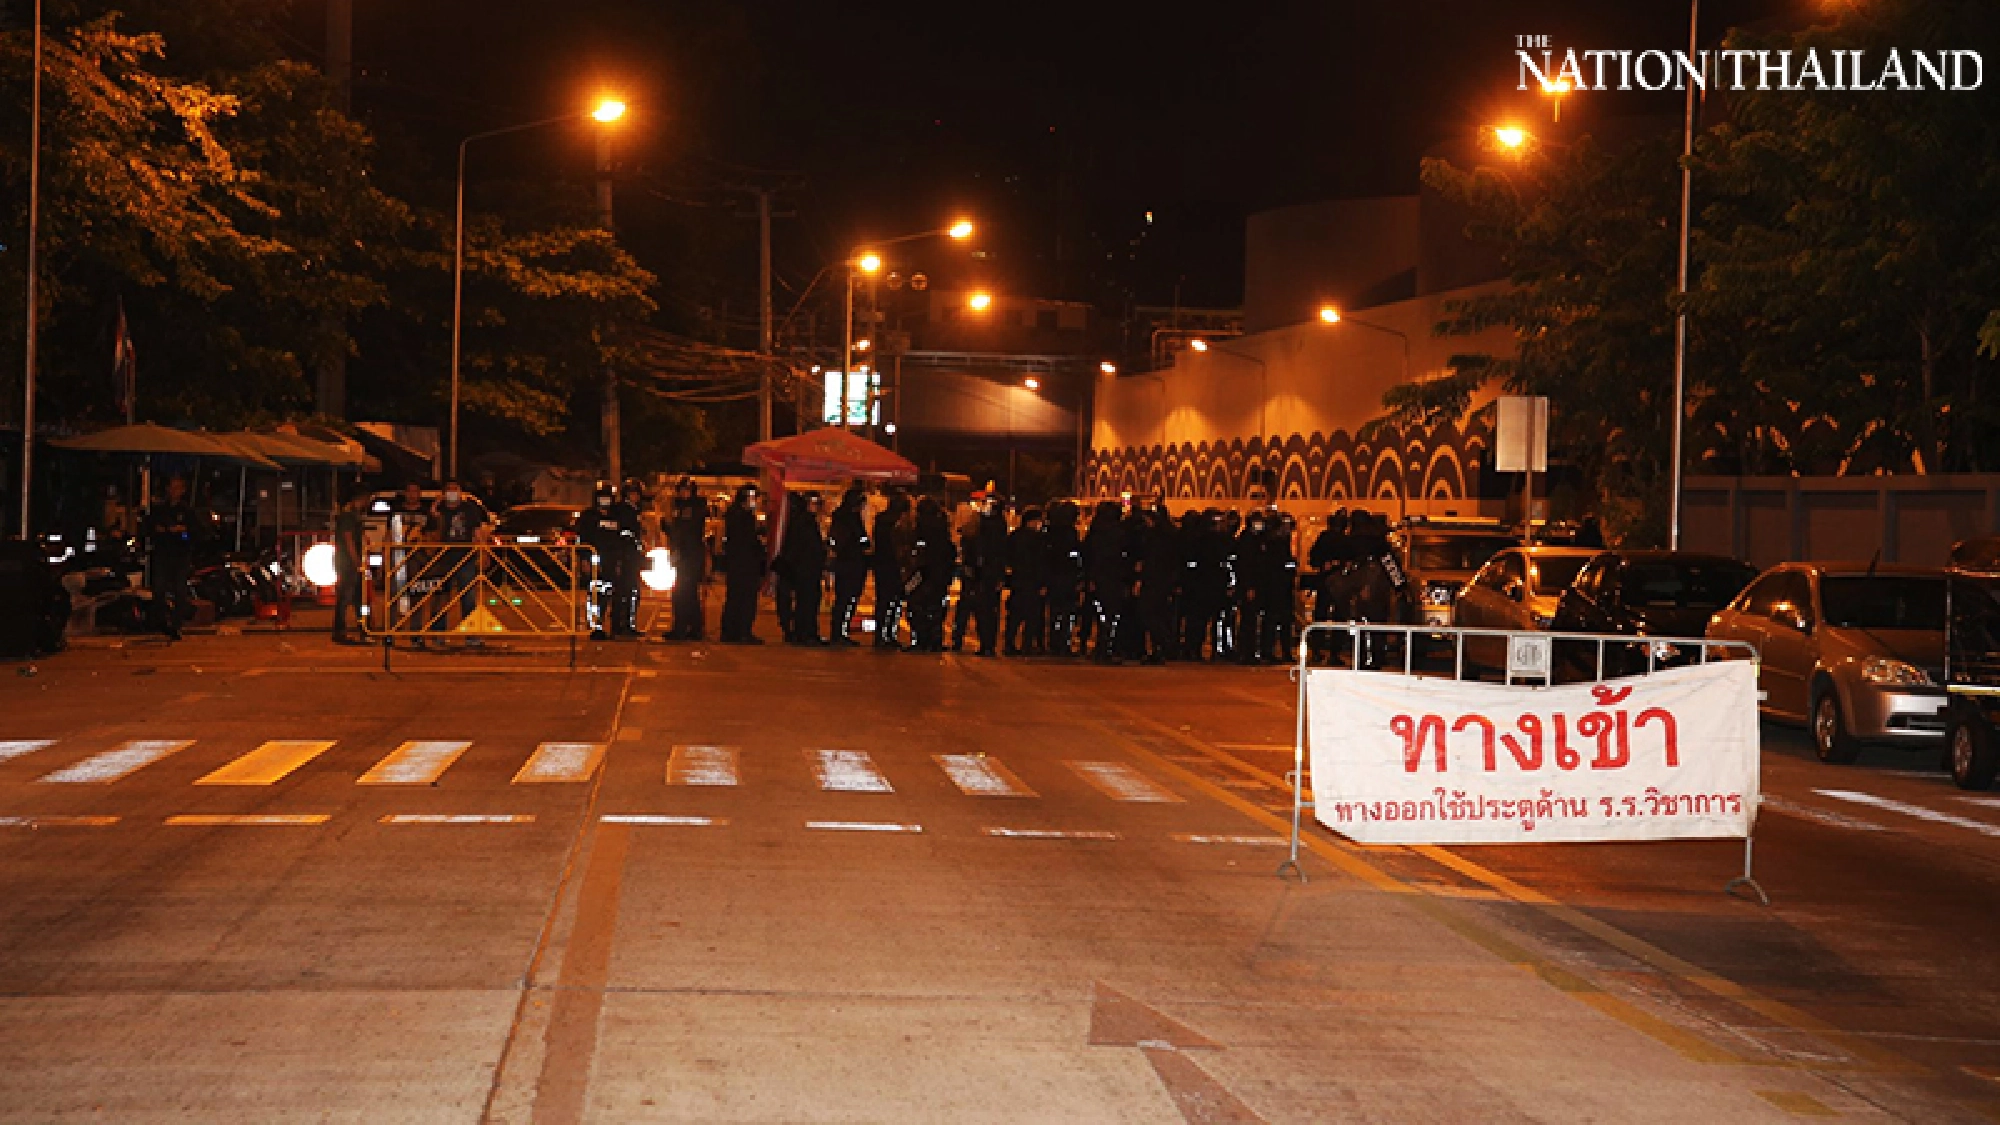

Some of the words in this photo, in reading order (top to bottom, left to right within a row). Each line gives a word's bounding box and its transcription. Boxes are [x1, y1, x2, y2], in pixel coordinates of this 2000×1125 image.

[1389, 684, 1679, 773] ทางเข้า
[1334, 786, 1589, 832] ทางออกใช้ประตูด้าน
